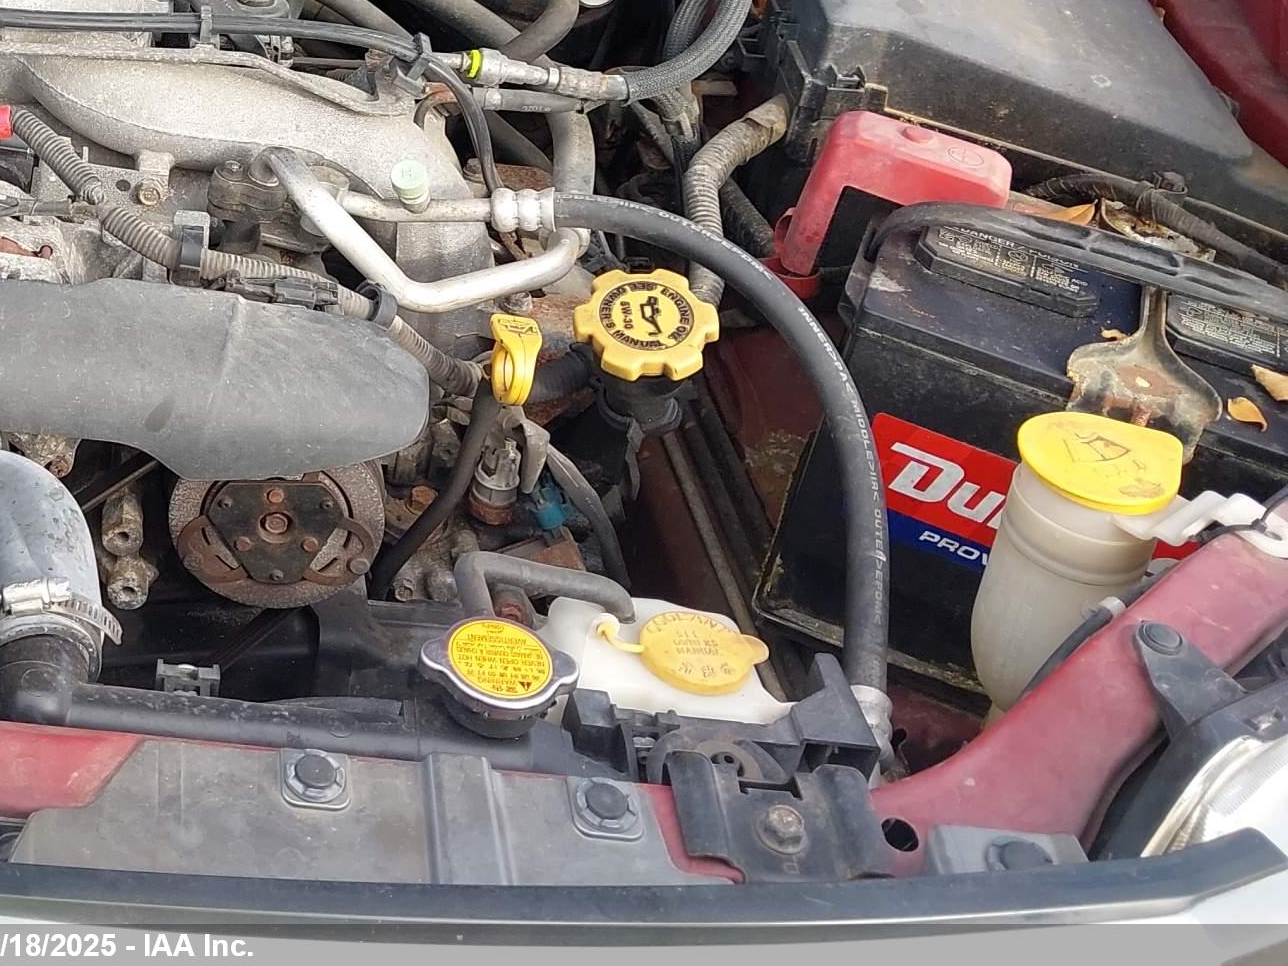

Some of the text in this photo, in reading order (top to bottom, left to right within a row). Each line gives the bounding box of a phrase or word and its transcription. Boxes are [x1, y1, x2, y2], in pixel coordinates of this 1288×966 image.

[620, 301, 635, 331] 5W-30
[660, 287, 691, 342] ENGINE OIL
[457, 653, 545, 668] NEVER OPEN WHEN HOT
[477, 676, 518, 686] WARNING
